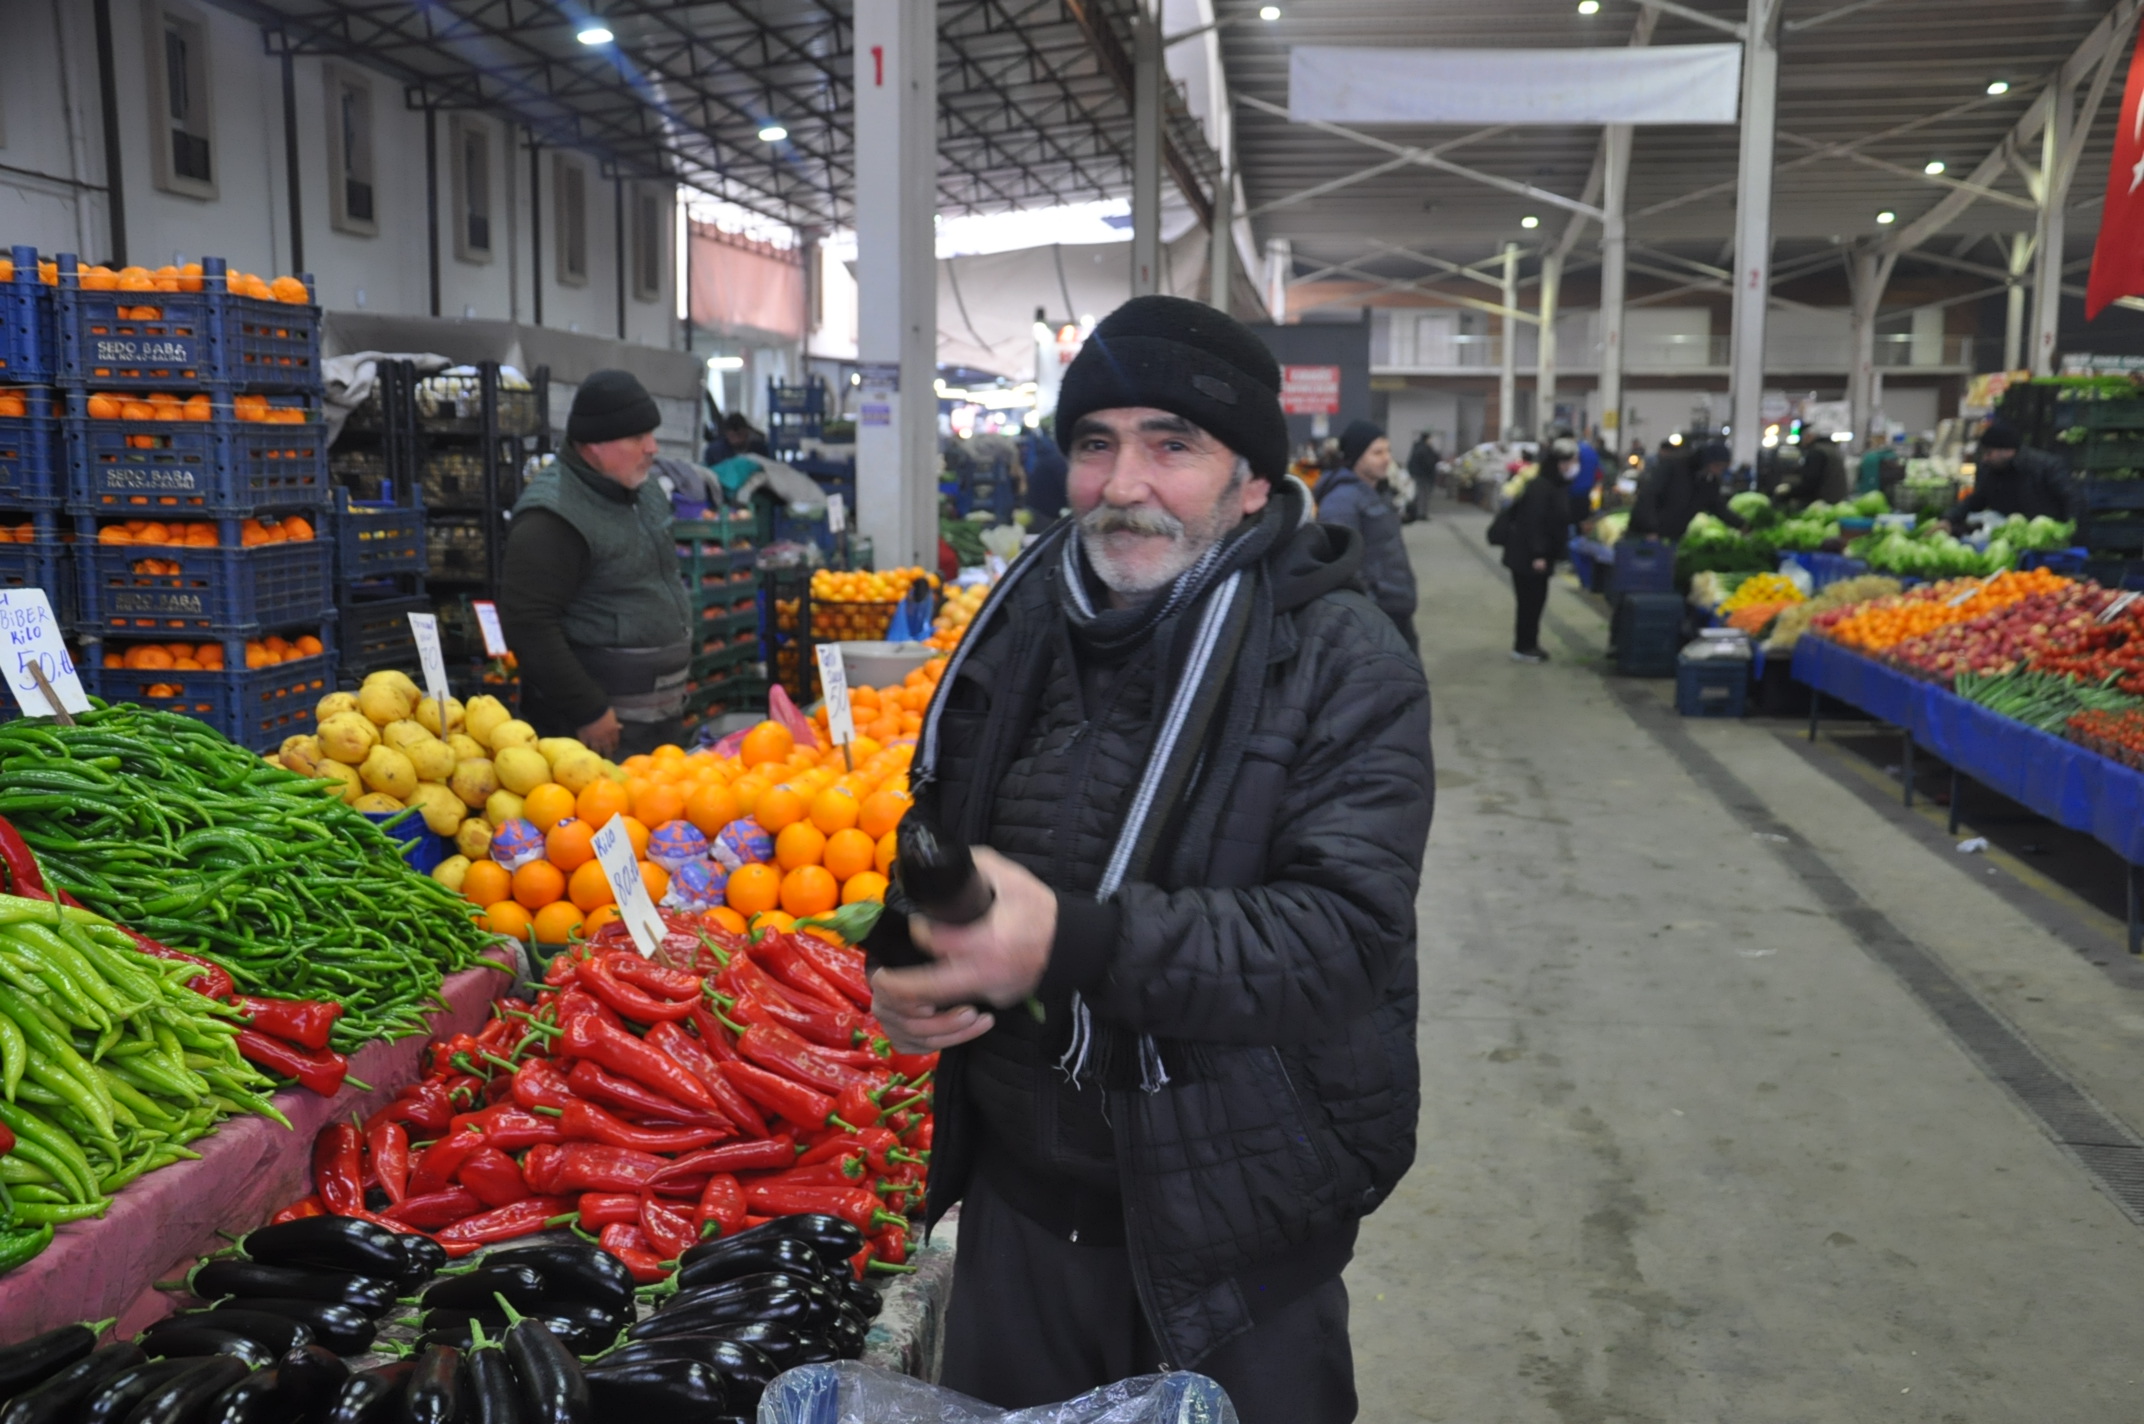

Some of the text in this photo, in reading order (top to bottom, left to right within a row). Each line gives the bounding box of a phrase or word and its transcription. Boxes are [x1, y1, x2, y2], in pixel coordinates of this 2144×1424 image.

[870, 45, 883, 87] 1
[97, 341, 184, 355] SEDO BABA
[107, 469, 194, 482] SEDO BABA
